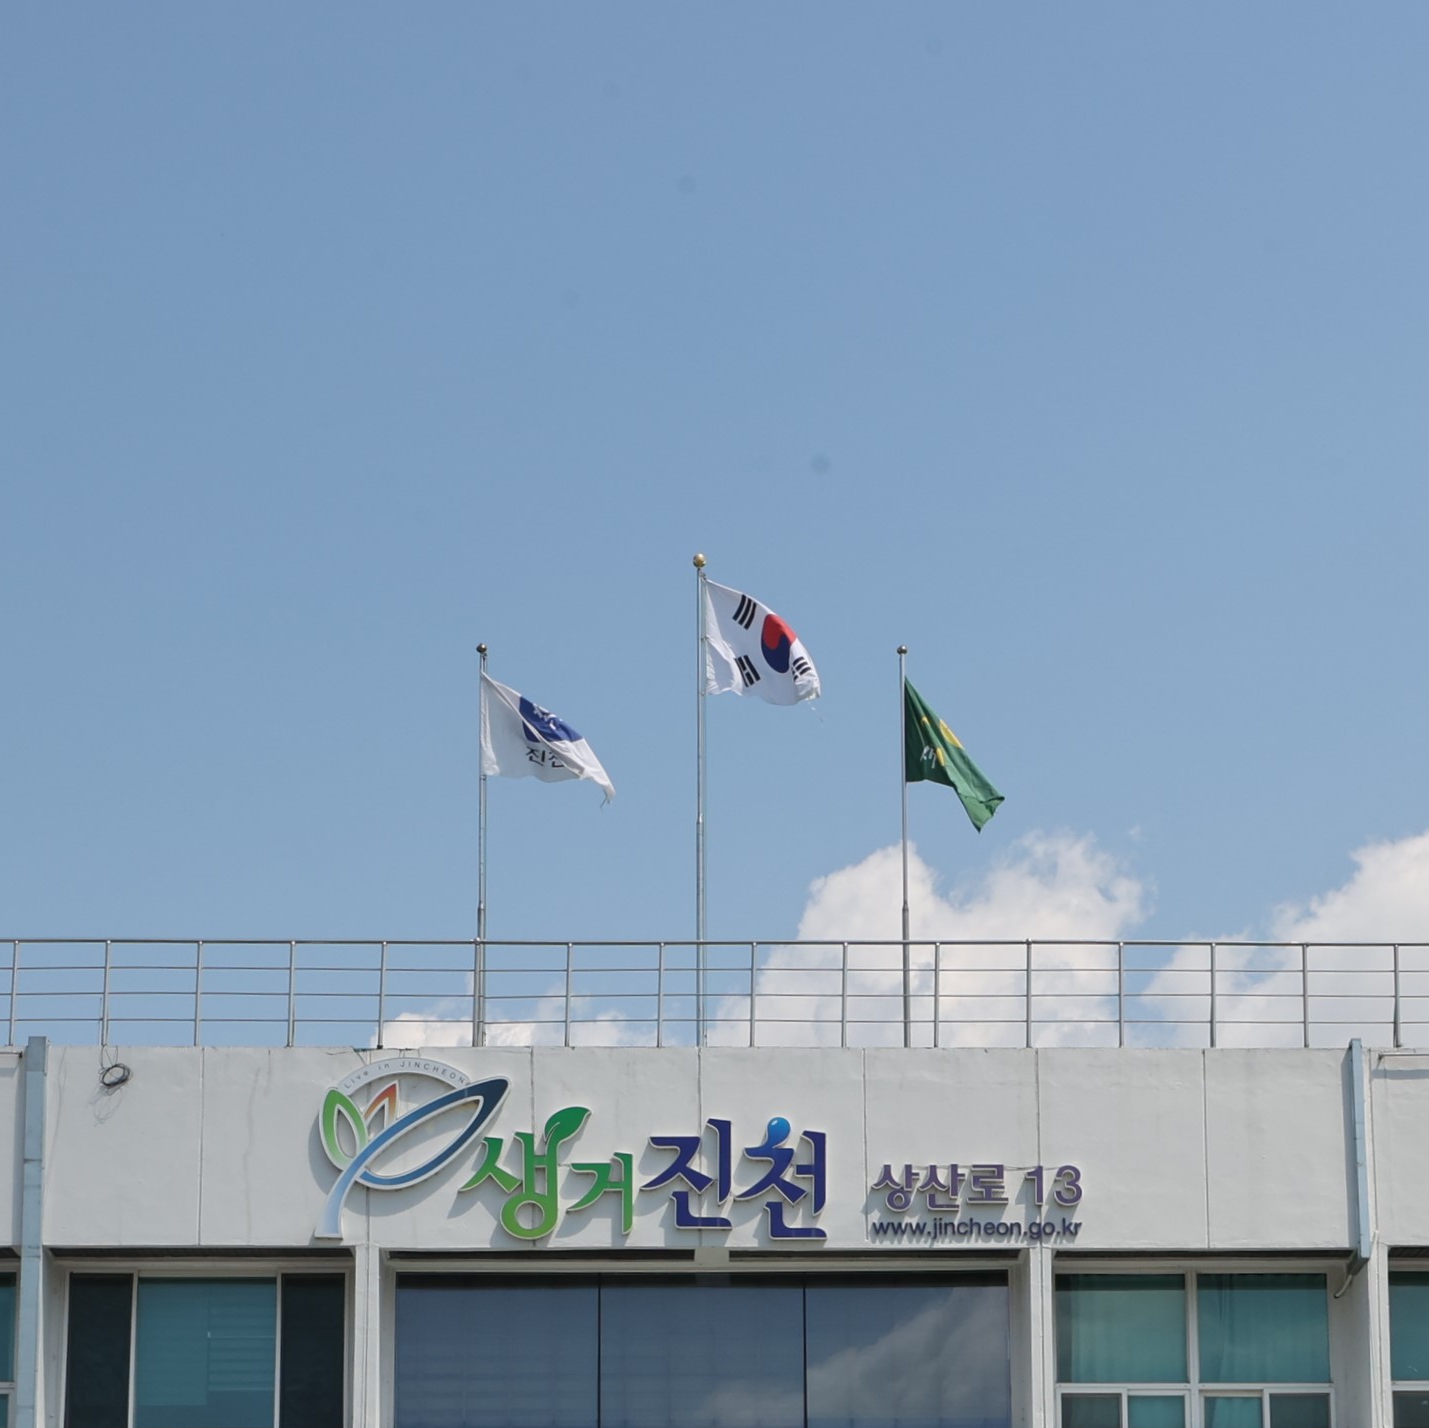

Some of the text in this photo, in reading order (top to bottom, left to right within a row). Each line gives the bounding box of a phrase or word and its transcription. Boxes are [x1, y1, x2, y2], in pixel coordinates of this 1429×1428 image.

[343, 1060, 466, 1089] Live in JINCHEON
[872, 1164, 1083, 1212] 상산로 13
[872, 1217, 1083, 1239] www.jincheon.go.kr
